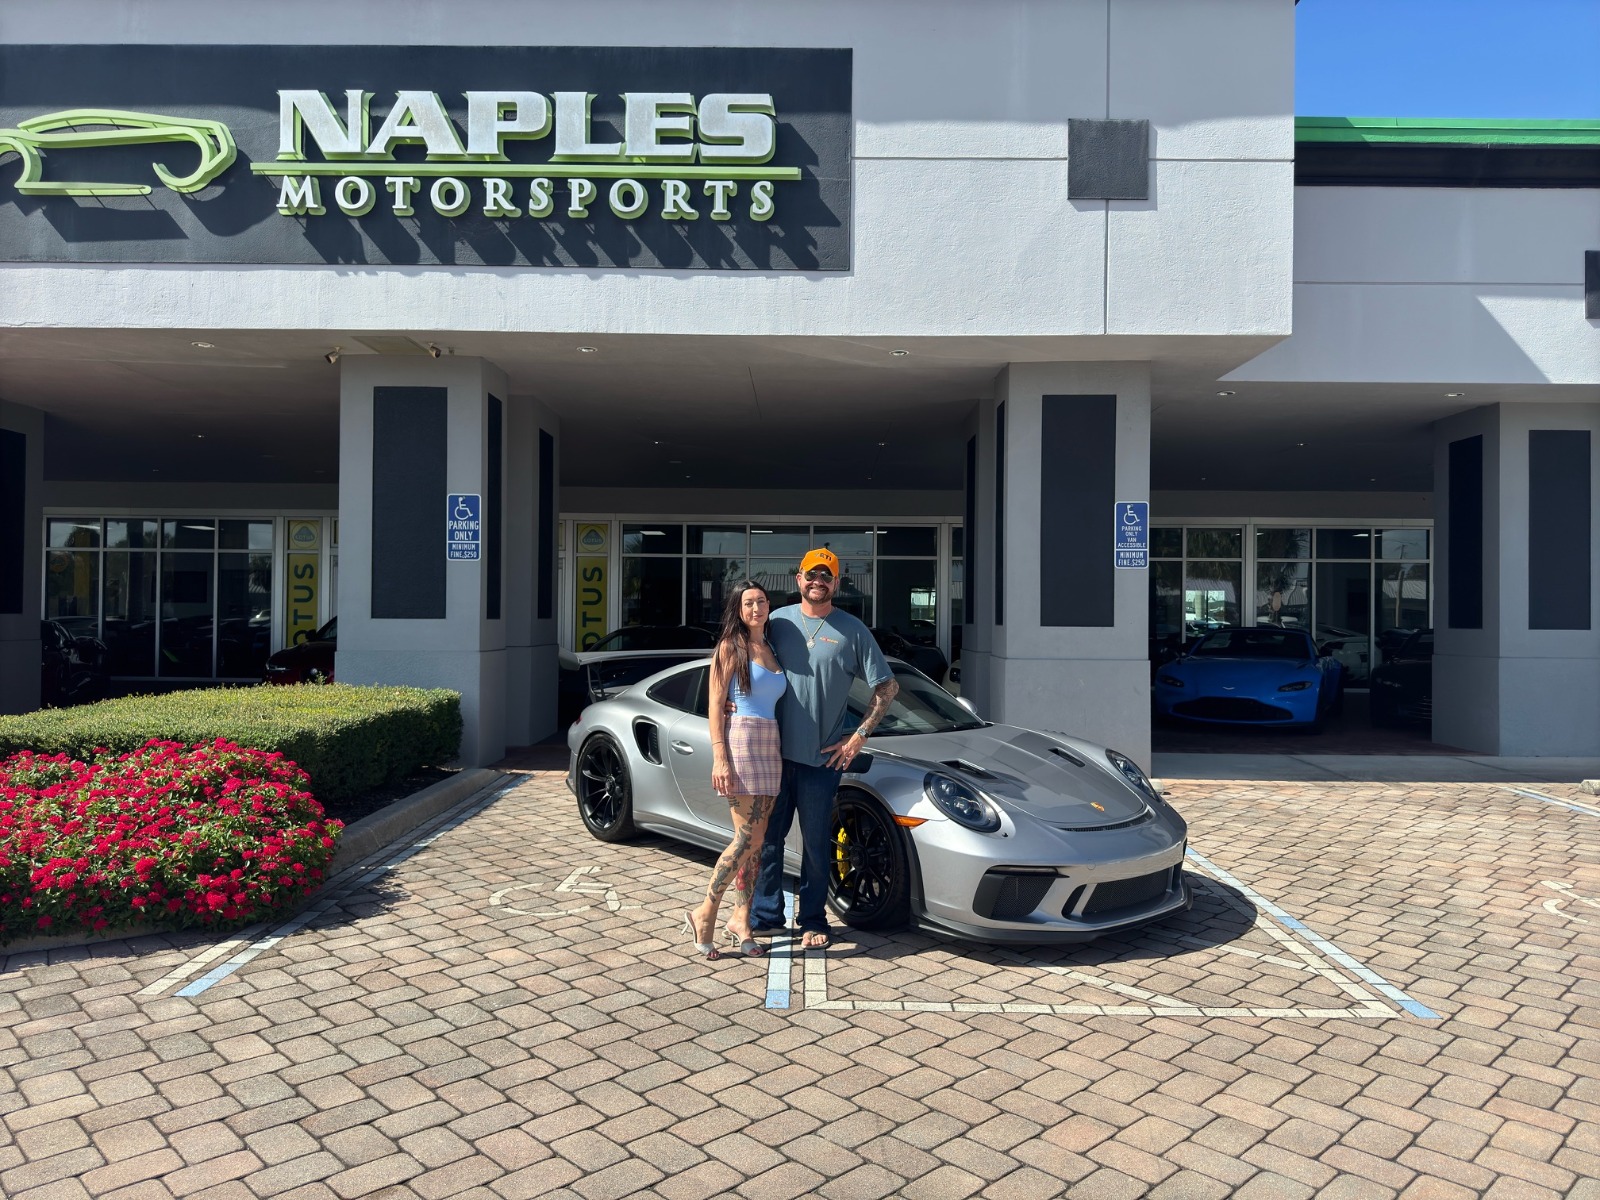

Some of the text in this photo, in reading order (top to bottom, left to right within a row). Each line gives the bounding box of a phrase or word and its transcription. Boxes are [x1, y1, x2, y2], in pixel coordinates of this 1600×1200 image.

[276, 89, 777, 165] NAPLES
[276, 175, 775, 221] MOTORSPORTS
[448, 520, 479, 530] PARKING
[454, 531, 473, 541] ONLY
[451, 543, 476, 551] MINIMUM
[463, 550, 477, 559] $250
[1119, 551, 1144, 559] MINIMUM
[1131, 558, 1145, 567] $250
